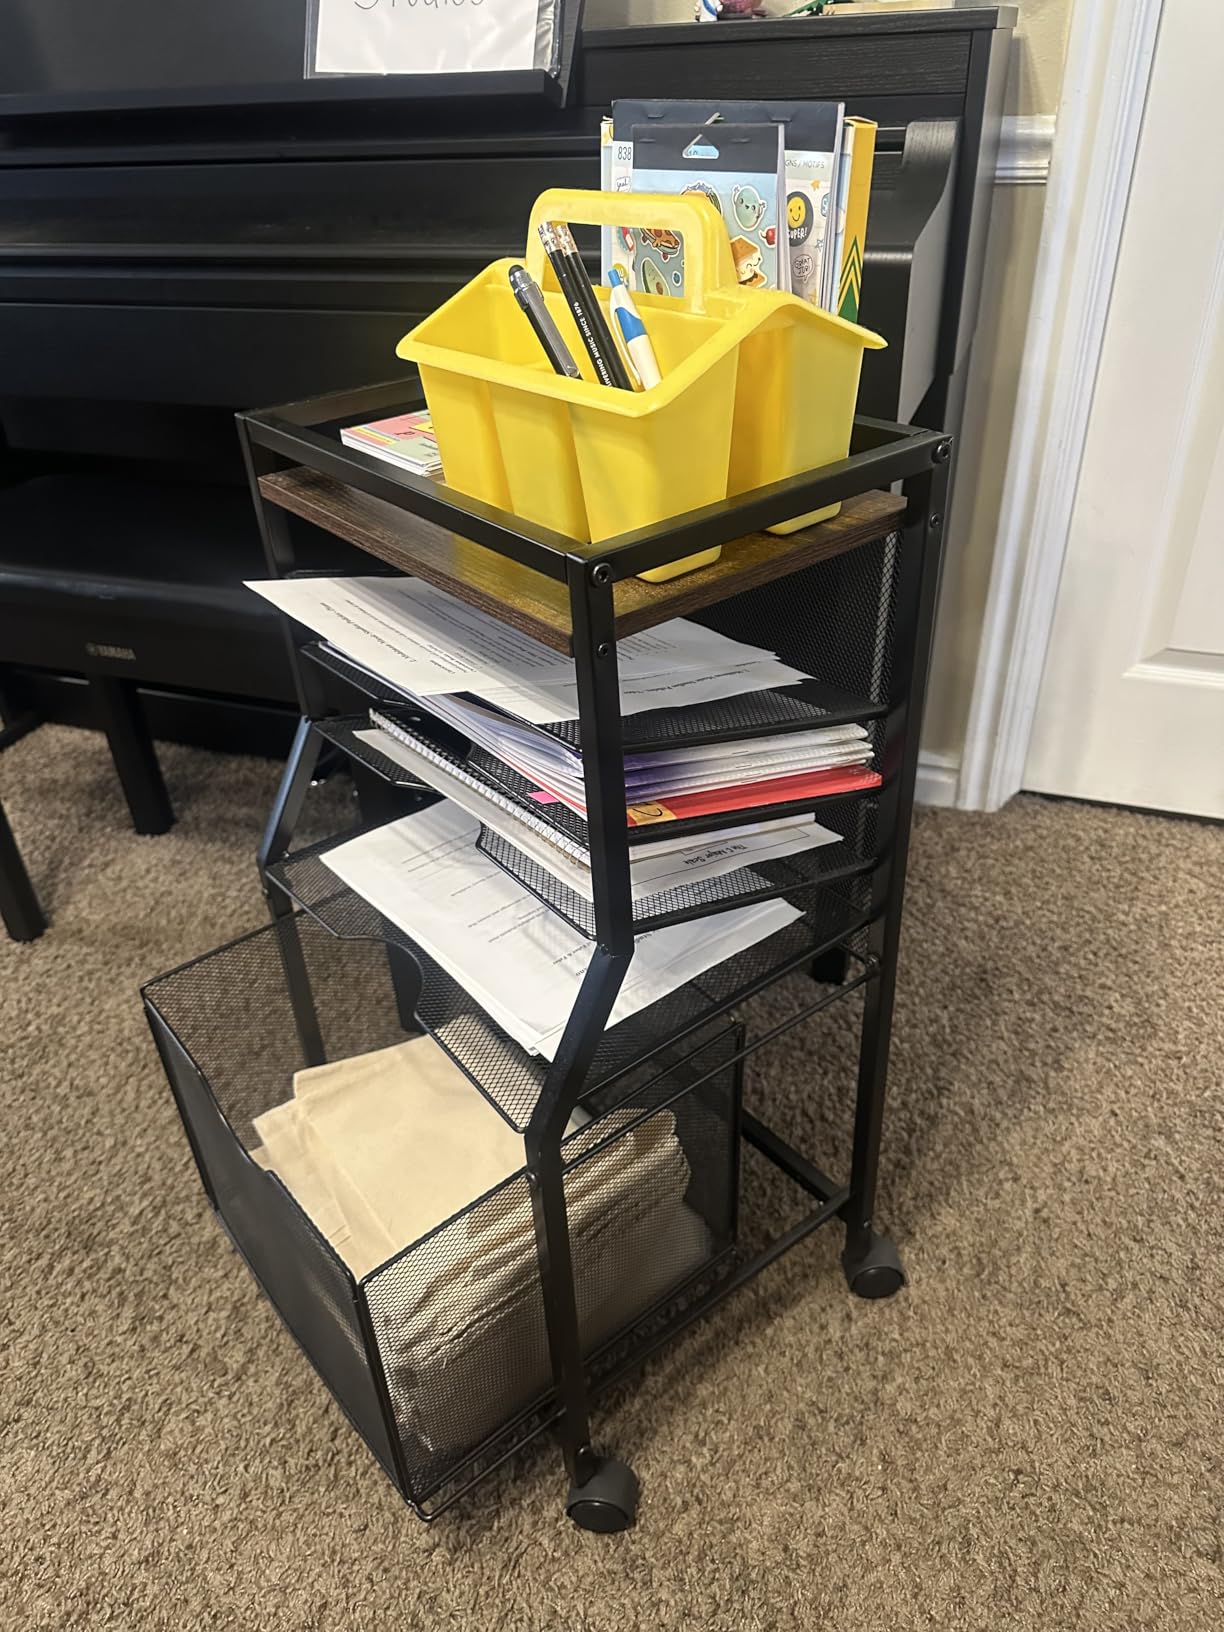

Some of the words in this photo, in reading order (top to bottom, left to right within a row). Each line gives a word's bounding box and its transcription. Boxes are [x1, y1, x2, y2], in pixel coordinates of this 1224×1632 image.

[617, 146, 632, 161] 838
[573, 301, 583, 317] 1876
[580, 317, 592, 337] SINCE
[587, 337, 600, 358] MUSIC
